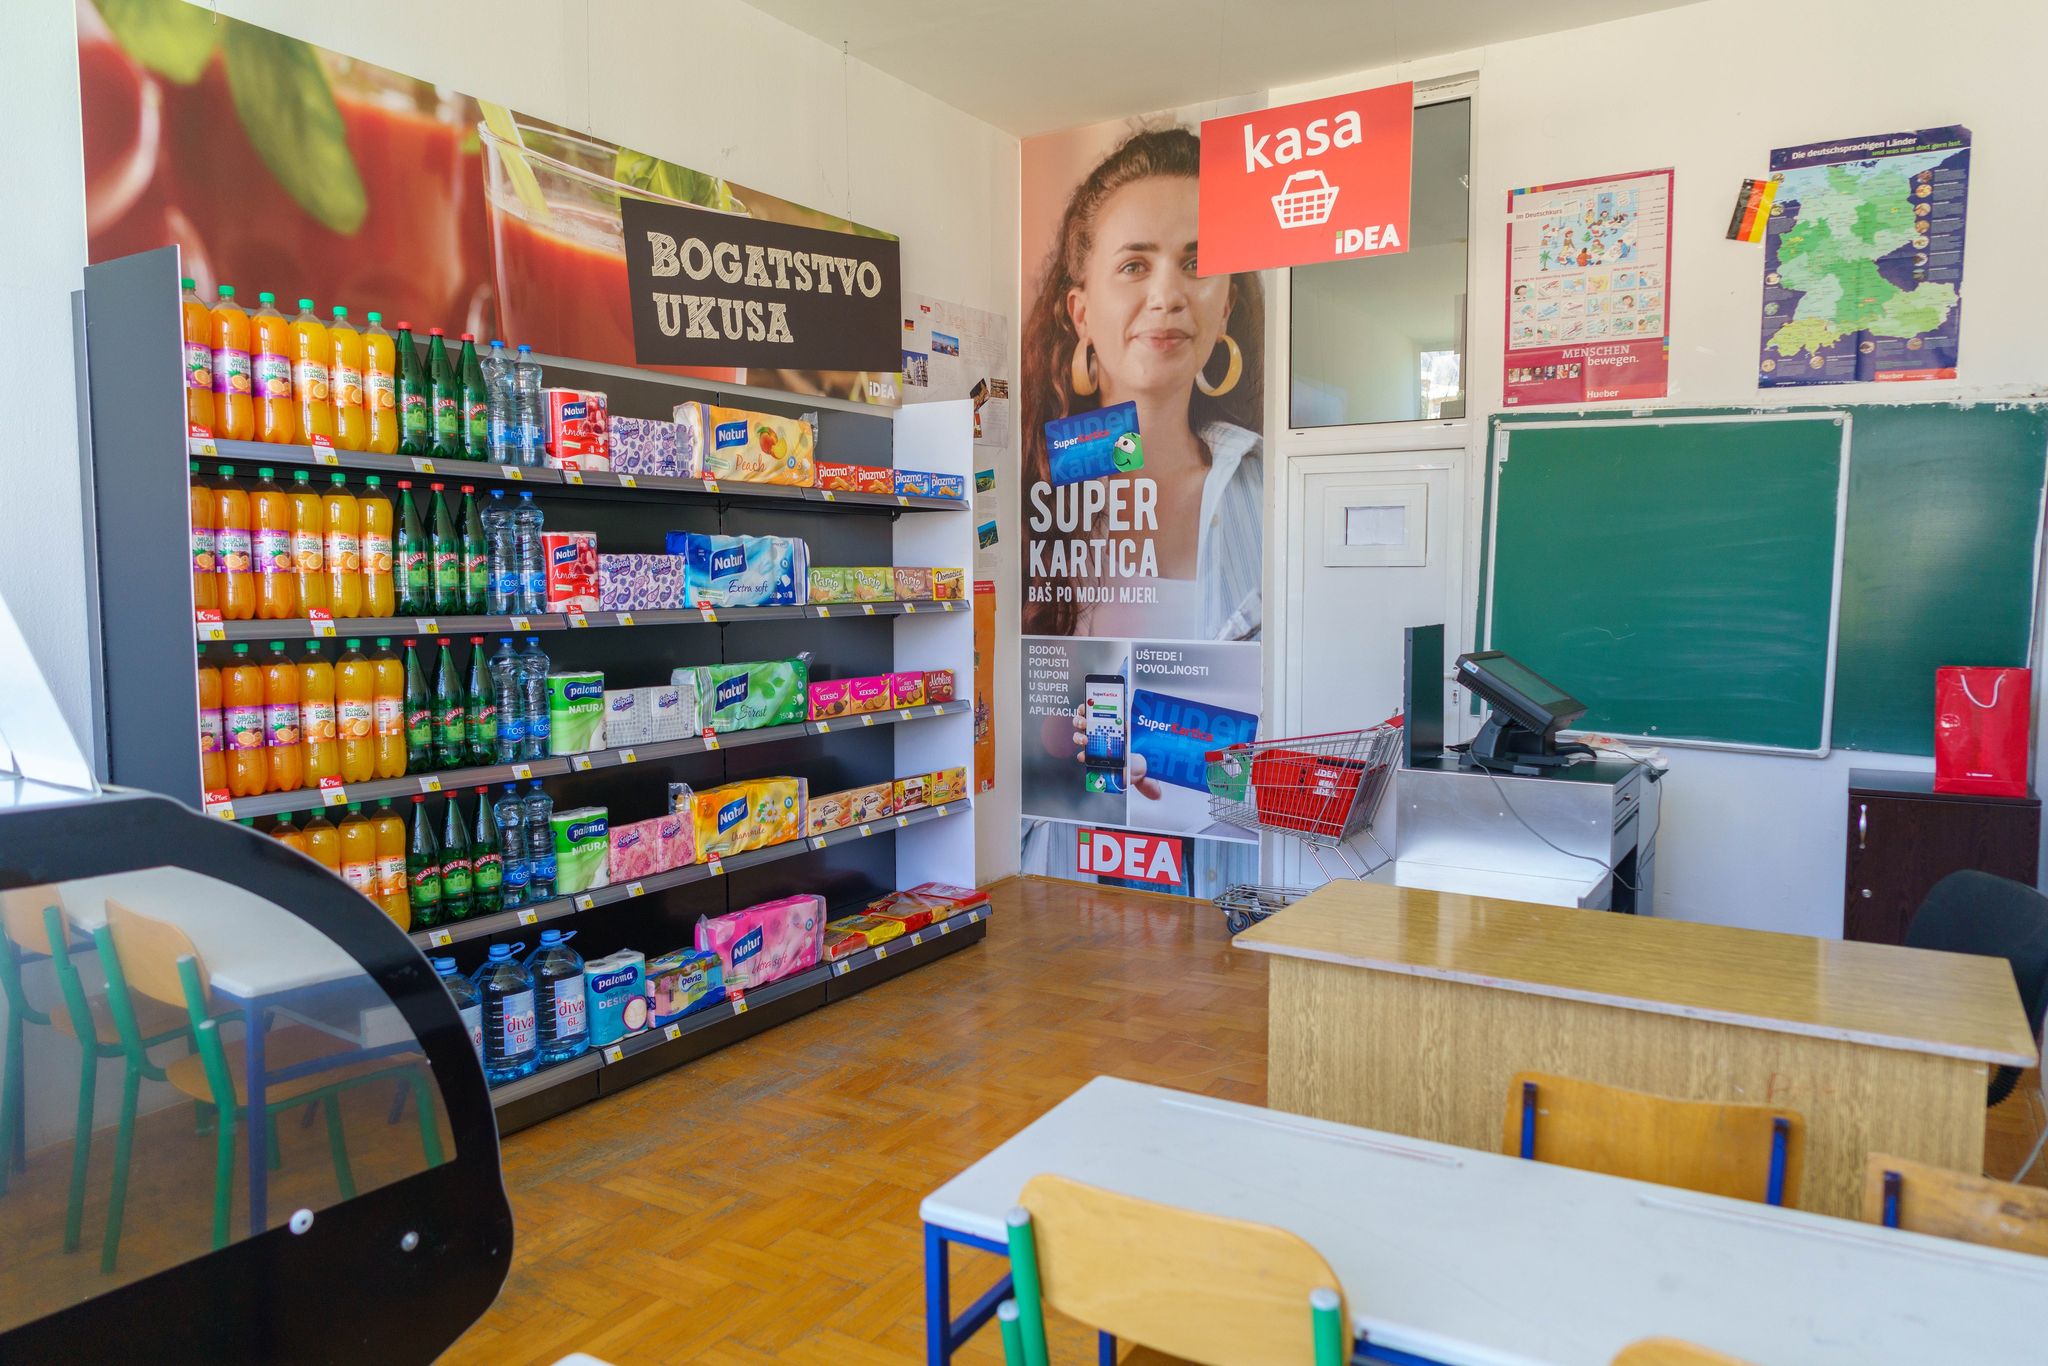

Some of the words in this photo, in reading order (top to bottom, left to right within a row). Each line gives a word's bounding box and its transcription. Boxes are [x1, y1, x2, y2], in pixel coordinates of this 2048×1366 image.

[1243, 110, 1363, 173] kasa
[1792, 151, 1805, 160] Die
[1807, 142, 1885, 158] deutschsprachigen
[1887, 137, 1917, 147] Länder
[1525, 209, 1562, 218] Deutschkurs
[1335, 223, 1400, 254] iDEA
[647, 231, 882, 298] BOGATSTVO
[652, 292, 794, 343] UKUSA
[1562, 345, 1630, 359] MENSCHEN
[1587, 355, 1639, 366] bewegen.
[869, 382, 895, 399] iDEA
[1586, 390, 1619, 399] Hueber
[564, 405, 586, 417] Natur
[718, 428, 746, 442] Natur
[735, 454, 765, 472] Peach
[819, 467, 847, 481] plazma
[858, 470, 886, 481] plazma
[895, 473, 922, 486] plazma
[932, 476, 957, 487] plazma
[1030, 478, 1158, 532] SUPER
[556, 549, 577, 560] Natur
[714, 553, 744, 570] Natur
[1030, 539, 1158, 577] KARTICA
[533, 579, 546, 587] ros
[728, 579, 753, 594] Extra
[755, 581, 768, 595] soft
[1028, 582, 1052, 603] BAŠ
[1056, 586, 1072, 603] PO
[1077, 587, 1115, 603] MOJOJ
[1120, 587, 1159, 603] MJERI.
[196, 610, 206, 620] K
[309, 609, 317, 619] K
[1029, 646, 1067, 657] BODOVI,
[1136, 650, 1177, 661] UŠTEDE
[1029, 658, 1069, 668] POPUSTI
[1136, 664, 1209, 676] POVOLJNOSTI
[1033, 671, 1069, 680] KUPONI
[570, 681, 602, 696] paloma
[718, 682, 747, 703] Natur
[1029, 682, 1035, 691] U
[1037, 682, 1068, 692] SUPER
[1029, 694, 1070, 704] KARTICA
[568, 704, 605, 714] NATURA
[736, 704, 767, 720] Forest
[320, 778, 328, 788] K
[206, 792, 214, 802] K
[720, 802, 747, 825] Natur
[573, 823, 606, 838] paloma
[572, 841, 607, 856] NATURA
[1079, 832, 1181, 882] iDEA
[544, 866, 556, 875] ros
[734, 935, 761, 959] Natur
[598, 971, 634, 989] paloma
[558, 1000, 584, 1016] diva
[598, 993, 635, 1009] DESIGN
[507, 1015, 534, 1033] diva
[567, 1017, 579, 1027] 6L
[516, 1033, 528, 1043] 6L
